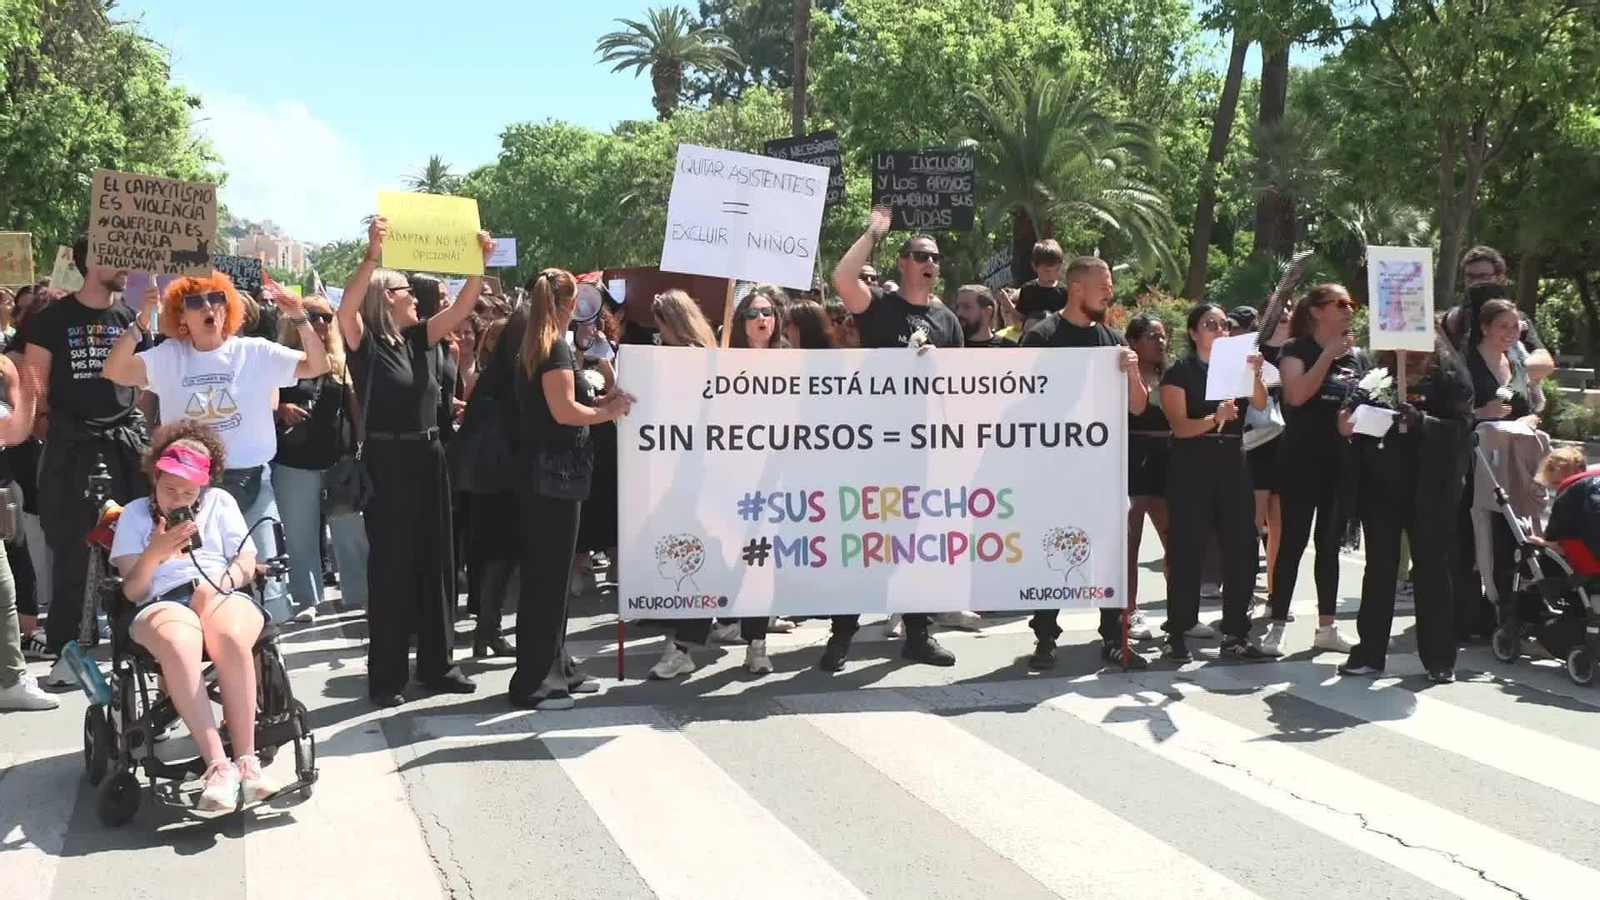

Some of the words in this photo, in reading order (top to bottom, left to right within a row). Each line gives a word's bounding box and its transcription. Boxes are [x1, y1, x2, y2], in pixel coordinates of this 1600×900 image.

[877, 153, 895, 170] LA
[104, 176, 120, 192] EL
[681, 156, 725, 179] QUITAR
[727, 164, 816, 197] ASISTENTES
[892, 173, 918, 190] LOS
[100, 194, 122, 210] ES
[133, 197, 205, 220] VIOLENCIA
[722, 201, 750, 215] =
[950, 193, 974, 207] SUS
[901, 209, 952, 227] VIDAS
[185, 222, 204, 237] ES
[672, 223, 728, 246] EXCLUIR
[108, 230, 172, 248] CREARLA
[388, 230, 432, 245] ADAPTAR
[435, 234, 450, 247] NO
[96, 254, 158, 272] INCLUSIVA
[86, 324, 126, 335] DERECHO
[70, 348, 88, 359] SUS
[70, 360, 88, 370] MIS
[702, 371, 801, 399] ¿DÓNDE
[809, 371, 863, 395] ESTÁ
[870, 376, 897, 395] LA
[904, 371, 1049, 395] INCLUSIÓN?
[638, 424, 693, 451] SIN
[706, 424, 874, 451] RECURSOS
[883, 431, 901, 443] =
[910, 423, 964, 449] SIN
[977, 421, 1109, 448] FUTURO
[737, 490, 827, 523] #SUS
[838, 485, 1014, 523] DERECHOS
[742, 535, 828, 568] #MIS
[841, 531, 1023, 568] PRINCIPIOS
